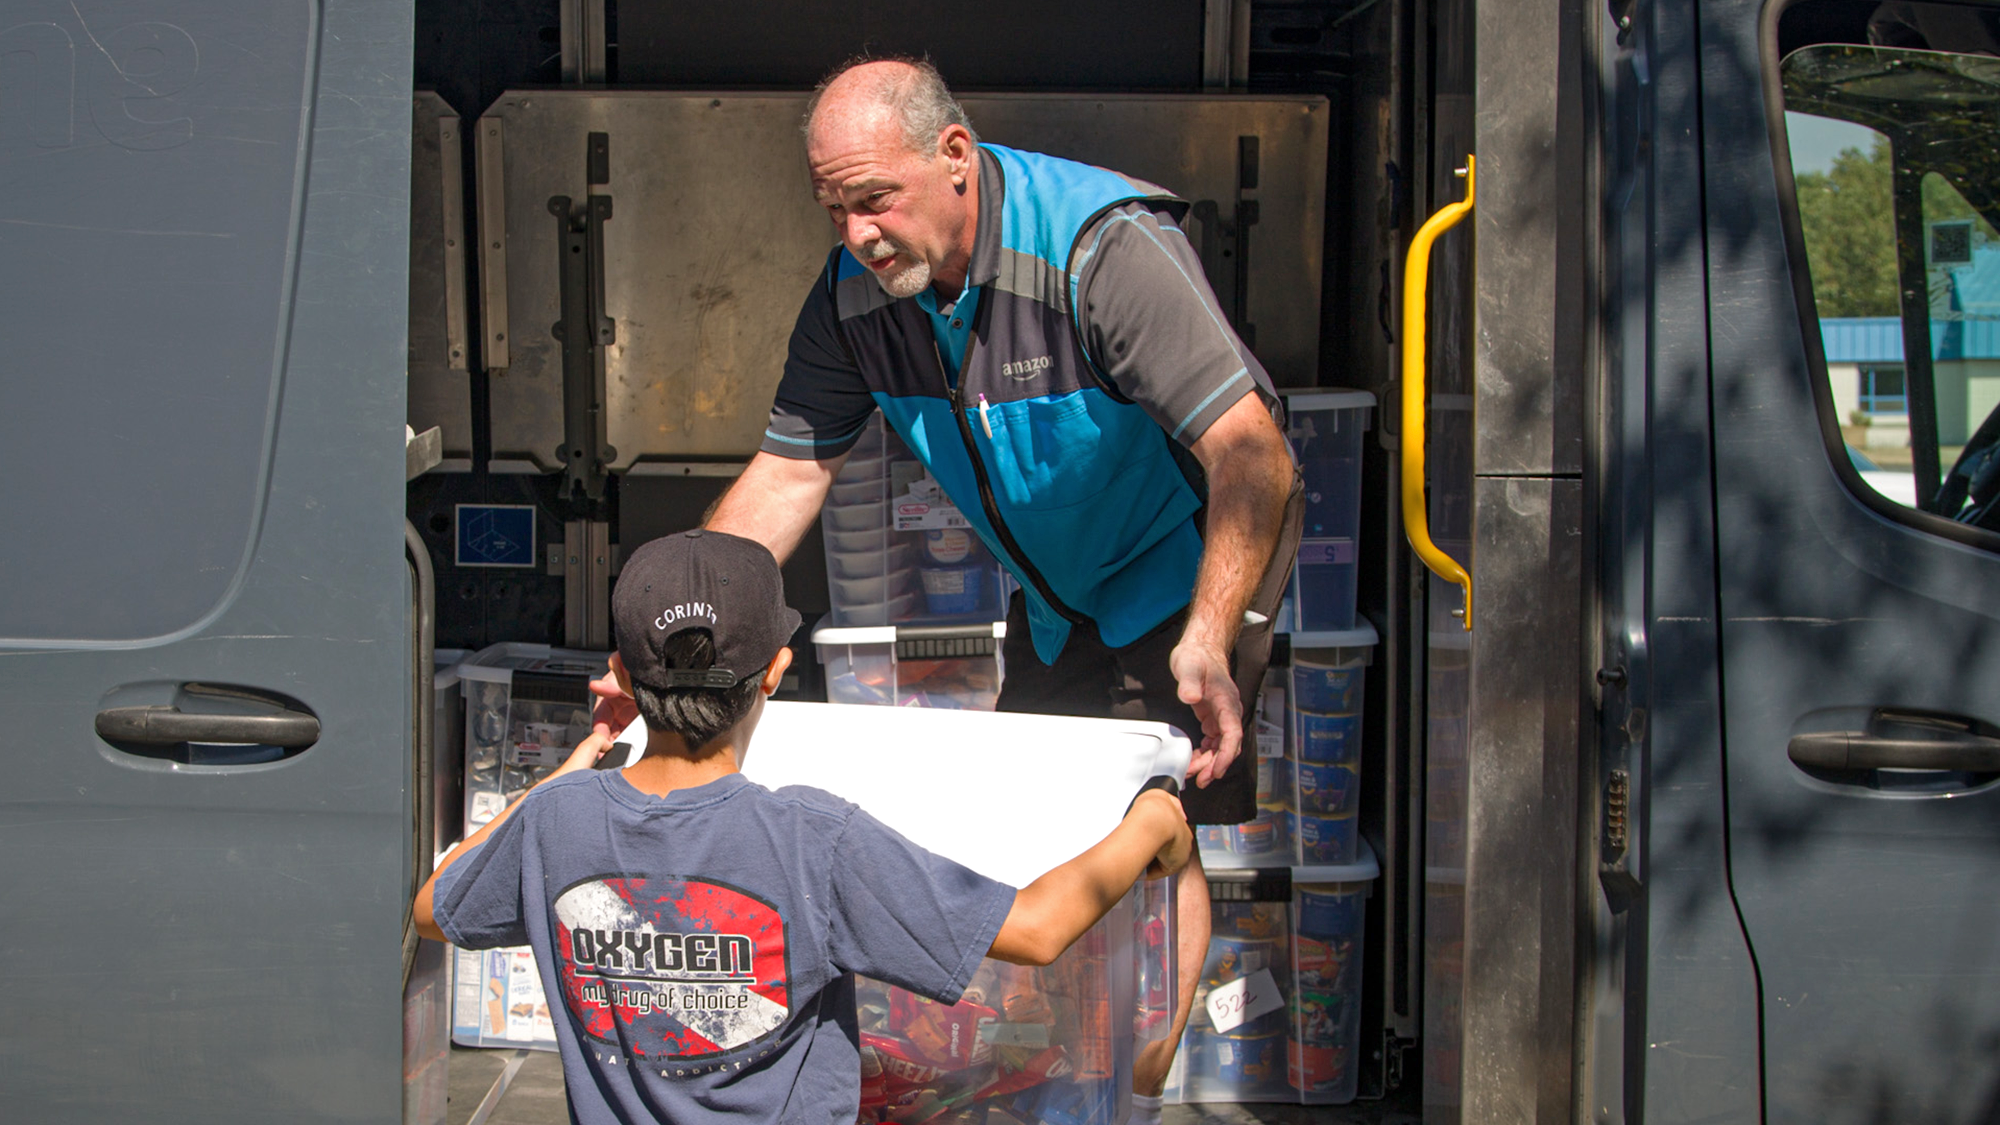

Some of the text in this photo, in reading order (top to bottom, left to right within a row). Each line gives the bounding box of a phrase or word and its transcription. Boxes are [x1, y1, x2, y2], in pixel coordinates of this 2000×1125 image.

[1002, 355, 1054, 377] amazon
[581, 984, 749, 1015] my drug of choice
[1215, 990, 1258, 1019] 522
